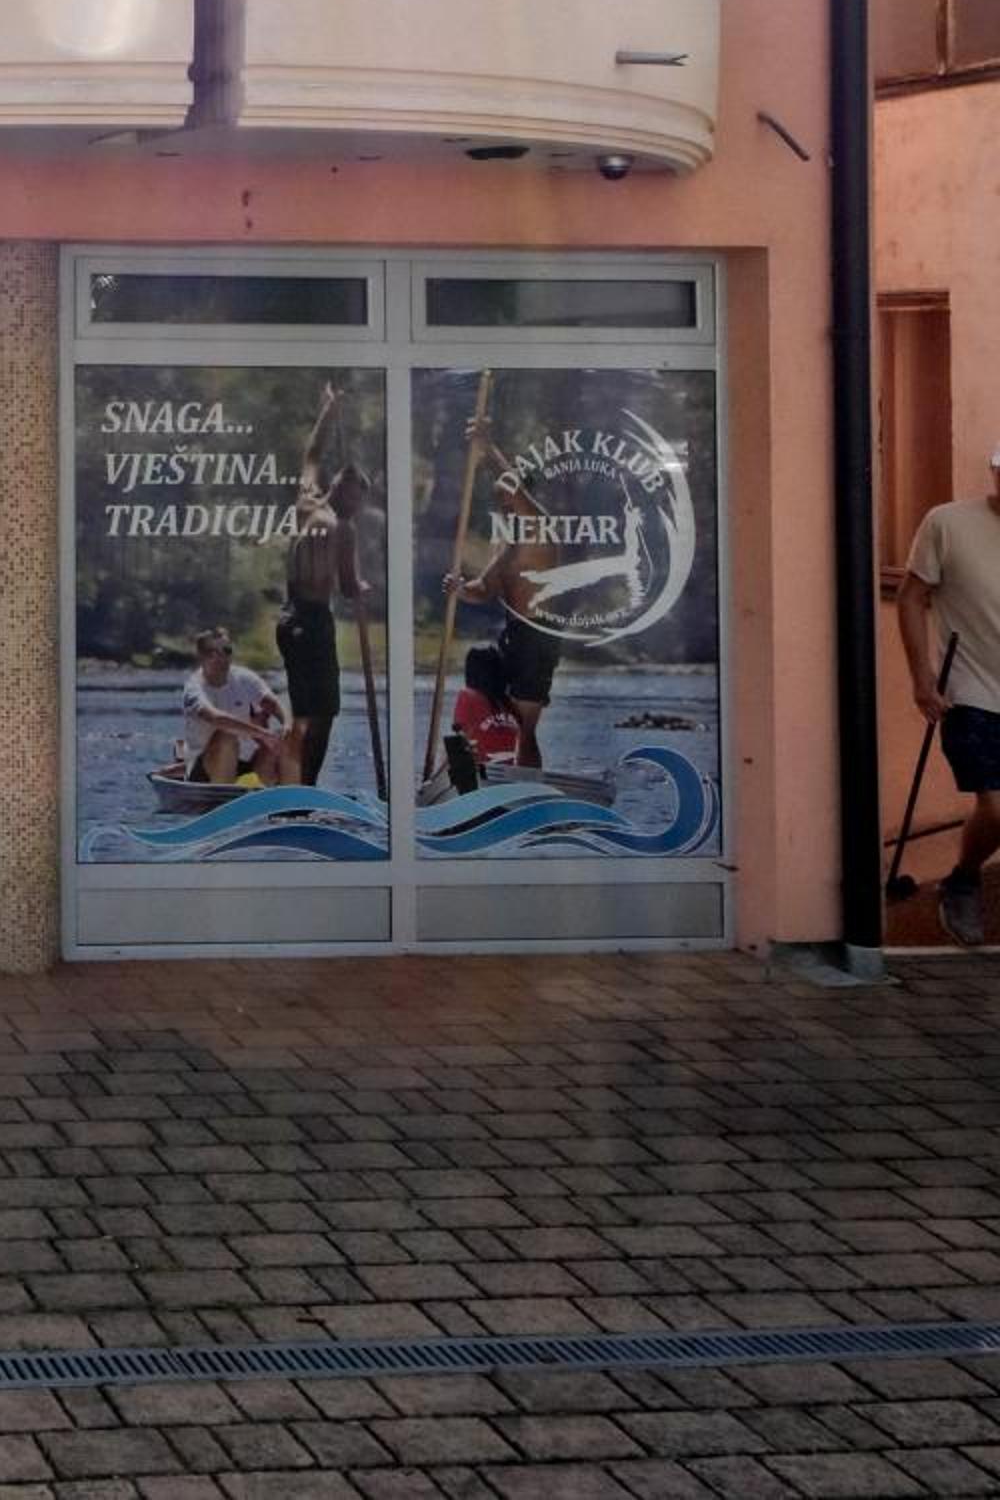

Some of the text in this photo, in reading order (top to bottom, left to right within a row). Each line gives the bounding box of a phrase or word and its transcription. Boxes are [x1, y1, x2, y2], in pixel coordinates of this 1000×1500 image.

[101, 401, 254, 434] SNAGA...
[105, 445, 305, 493] VJEŠTINA...
[496, 429, 665, 495] DAJAK KLUB
[544, 458, 617, 480] BANJA LUKA
[105, 504, 328, 544] TRADICIJA...
[489, 511, 622, 545] NEKTAR
